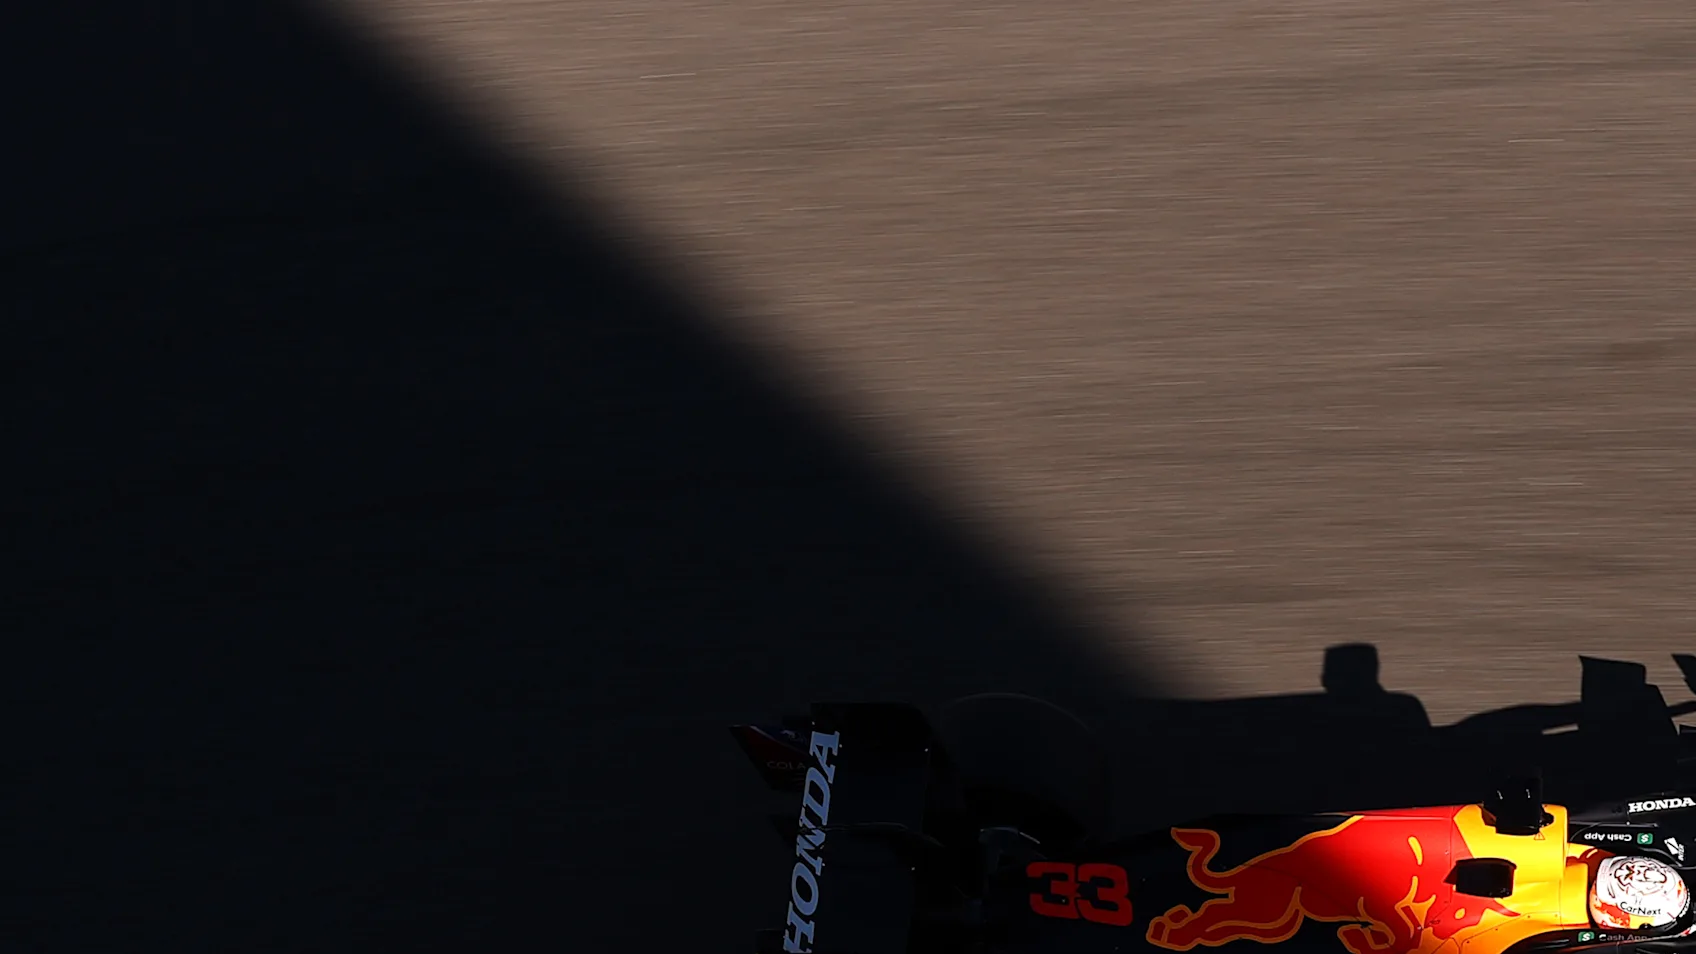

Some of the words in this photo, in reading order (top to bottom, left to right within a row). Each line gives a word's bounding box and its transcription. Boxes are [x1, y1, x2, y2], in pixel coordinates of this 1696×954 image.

[1628, 796, 1696, 814] HONDA
[783, 730, 841, 954] HONDA
[1583, 832, 1606, 842] App
[1607, 832, 1633, 842] Cash
[1025, 860, 1134, 928] 33
[1620, 901, 1661, 916] CarNext
[1599, 933, 1624, 942] Cash
